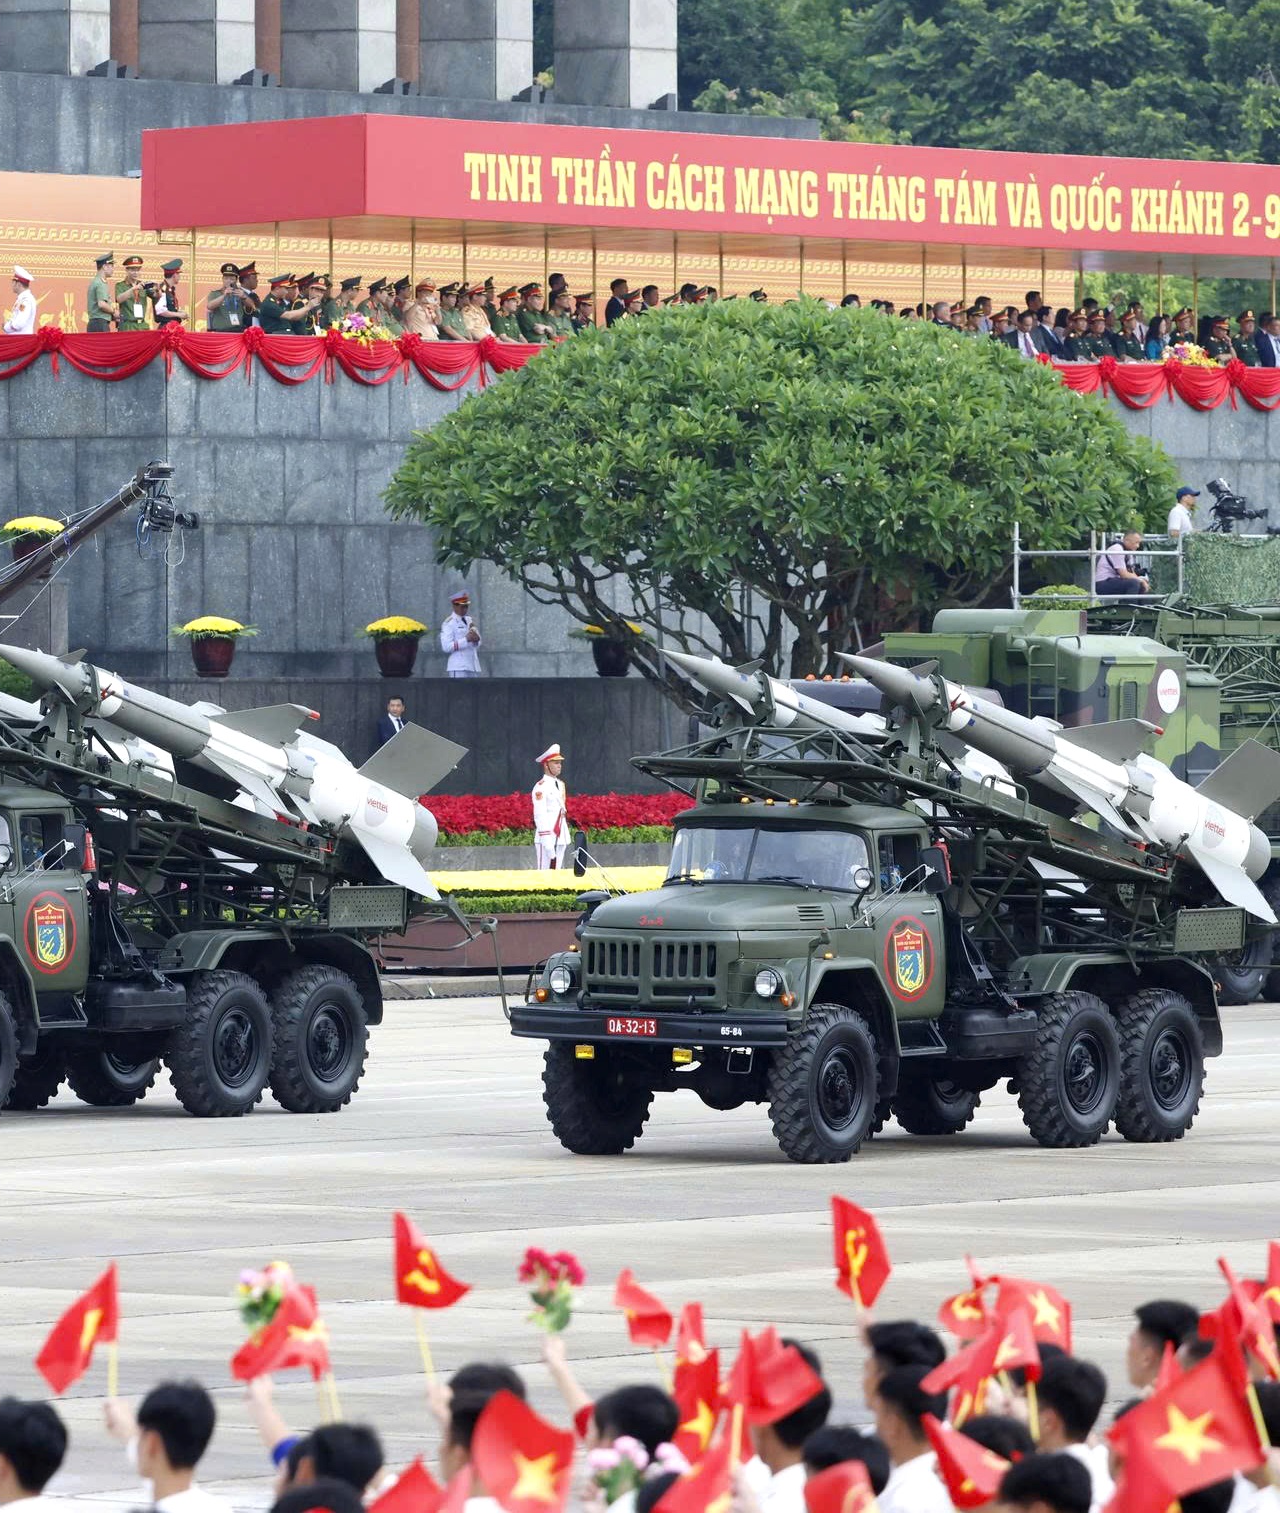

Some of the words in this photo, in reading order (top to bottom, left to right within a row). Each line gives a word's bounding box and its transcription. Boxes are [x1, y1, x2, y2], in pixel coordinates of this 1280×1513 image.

[463, 151, 543, 204] TINH
[550, 143, 637, 208] THẦN
[645, 152, 726, 213] CÁCH
[733, 166, 819, 226] MẠNG
[826, 164, 927, 224] THÁNG
[933, 168, 998, 227] TÁM
[1004, 172, 1044, 229] VÀ
[1049, 171, 1123, 234] QUỐC
[1130, 179, 1225, 236] KHÁNH
[1232, 191, 1280, 240] 2-9
[366, 796, 389, 814] viettel
[1204, 819, 1227, 838] viettel
